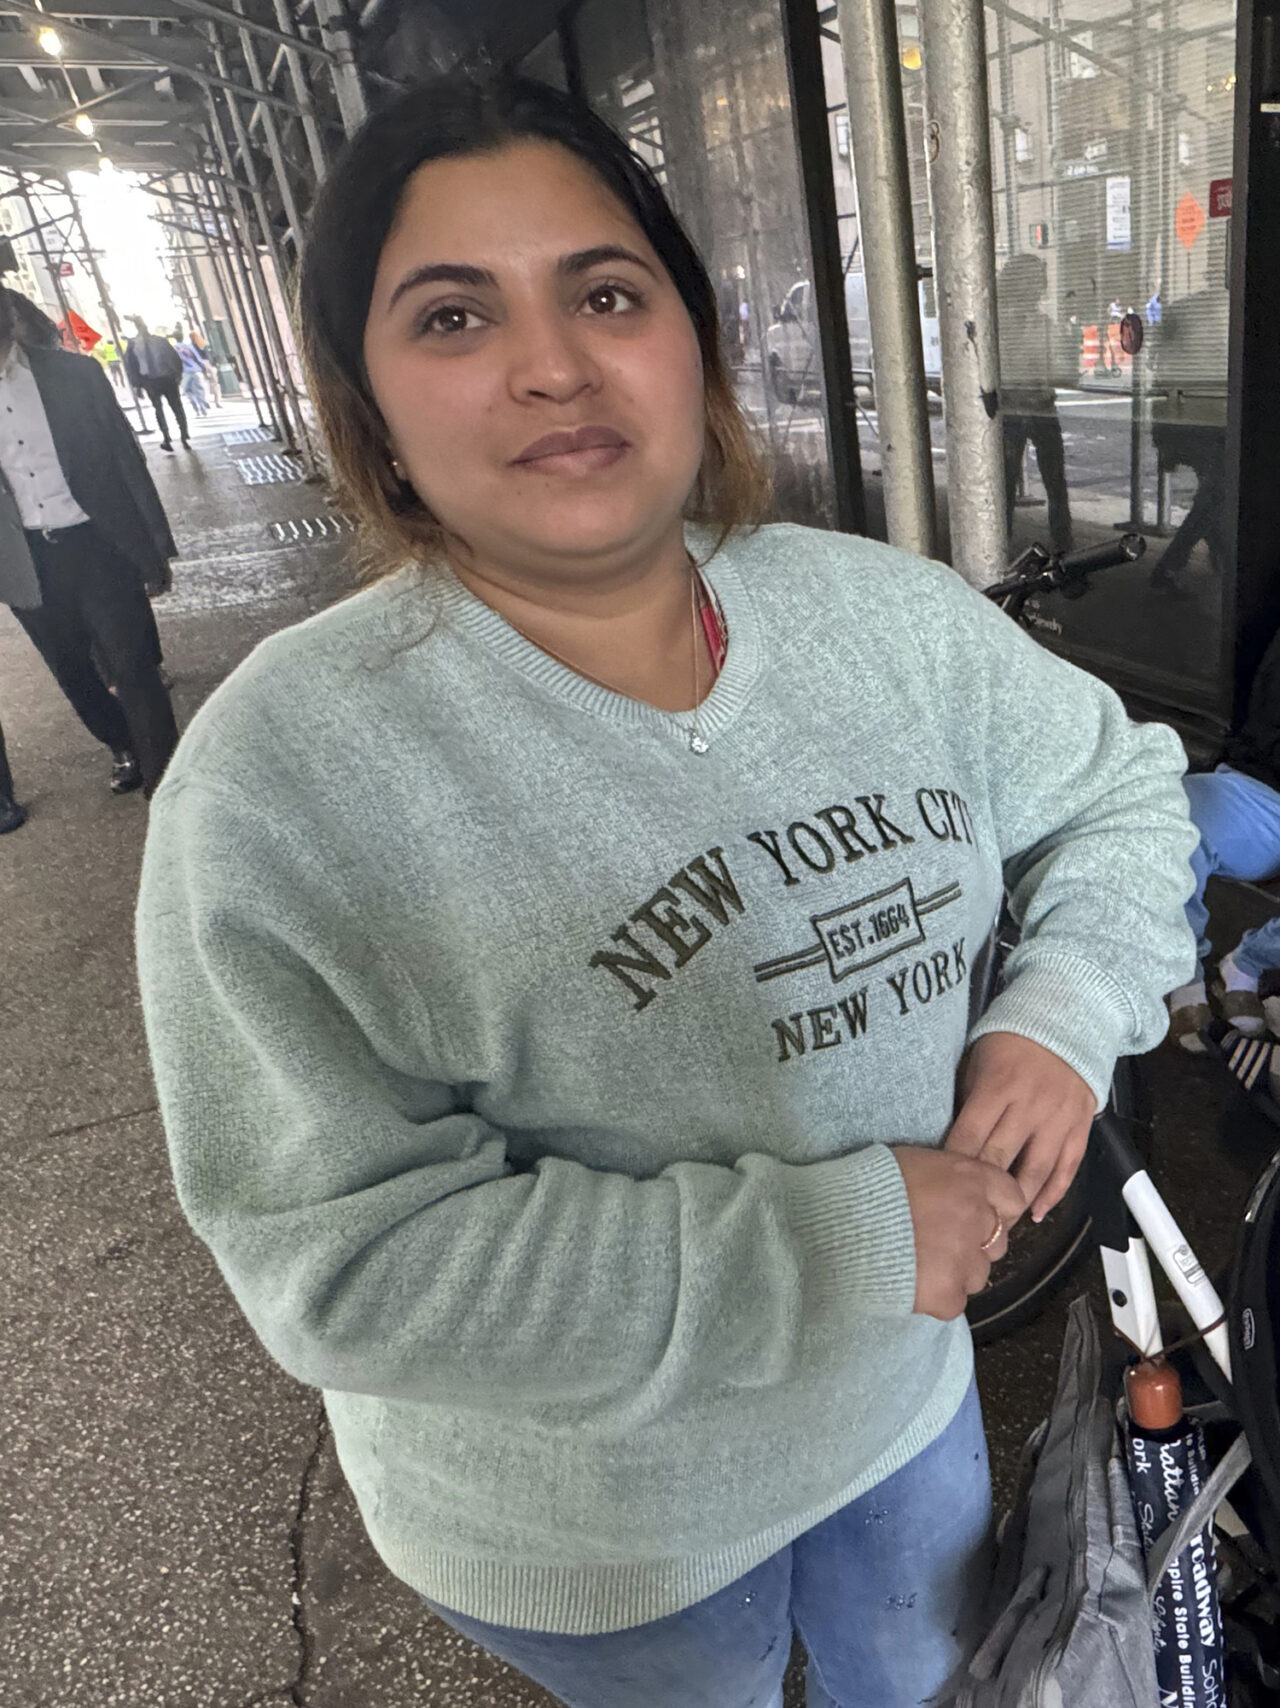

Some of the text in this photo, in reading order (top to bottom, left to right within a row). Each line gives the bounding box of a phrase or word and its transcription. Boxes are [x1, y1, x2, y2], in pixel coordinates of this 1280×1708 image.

[589, 846, 746, 1012] NEW
[746, 794, 915, 887] YORK
[771, 937, 967, 1063] NEW YORK
[1132, 1438, 1152, 1475] ork
[1174, 1607, 1190, 1649] State
[1190, 1534, 1216, 1647] roadway
[1179, 1655, 1196, 1708] Buildin
